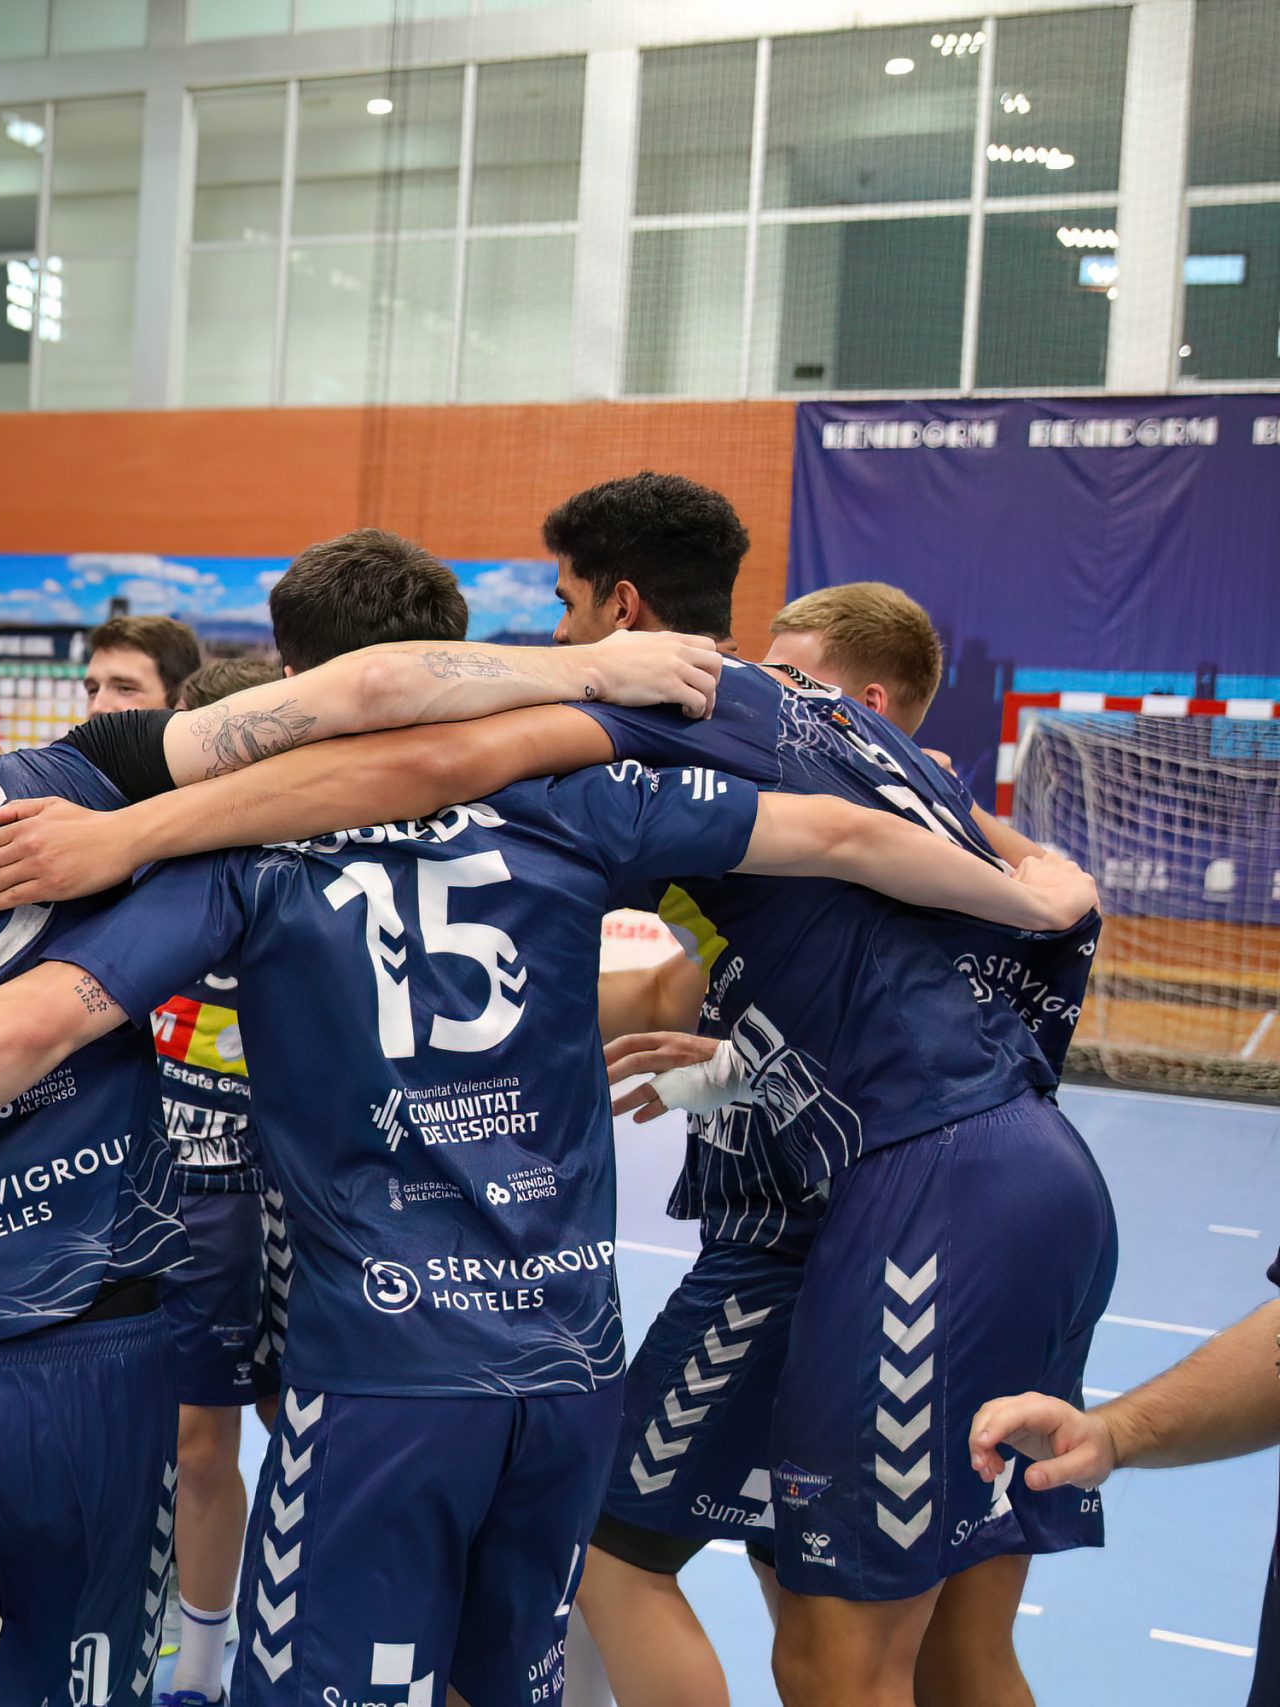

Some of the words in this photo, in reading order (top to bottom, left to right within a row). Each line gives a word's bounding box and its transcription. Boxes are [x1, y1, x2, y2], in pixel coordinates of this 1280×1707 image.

[822, 420, 998, 449] BENIDORM
[1029, 416, 1218, 447] BENIDORM
[322, 850, 527, 1059] 15
[162, 1061, 214, 1090] Estate
[453, 1076, 519, 1093] Valenciana
[19, 1087, 78, 1116] ALFONSO
[409, 1090, 521, 1125] COMUNITAT
[510, 1175, 555, 1193] TRINIDAD
[516, 1186, 557, 1204] ALFONSO
[426, 1241, 614, 1283] SERVIGROUP
[432, 1288, 544, 1312] HOTELES
[690, 1494, 762, 1527] Suma
[531, 1683, 550, 1704] DE
